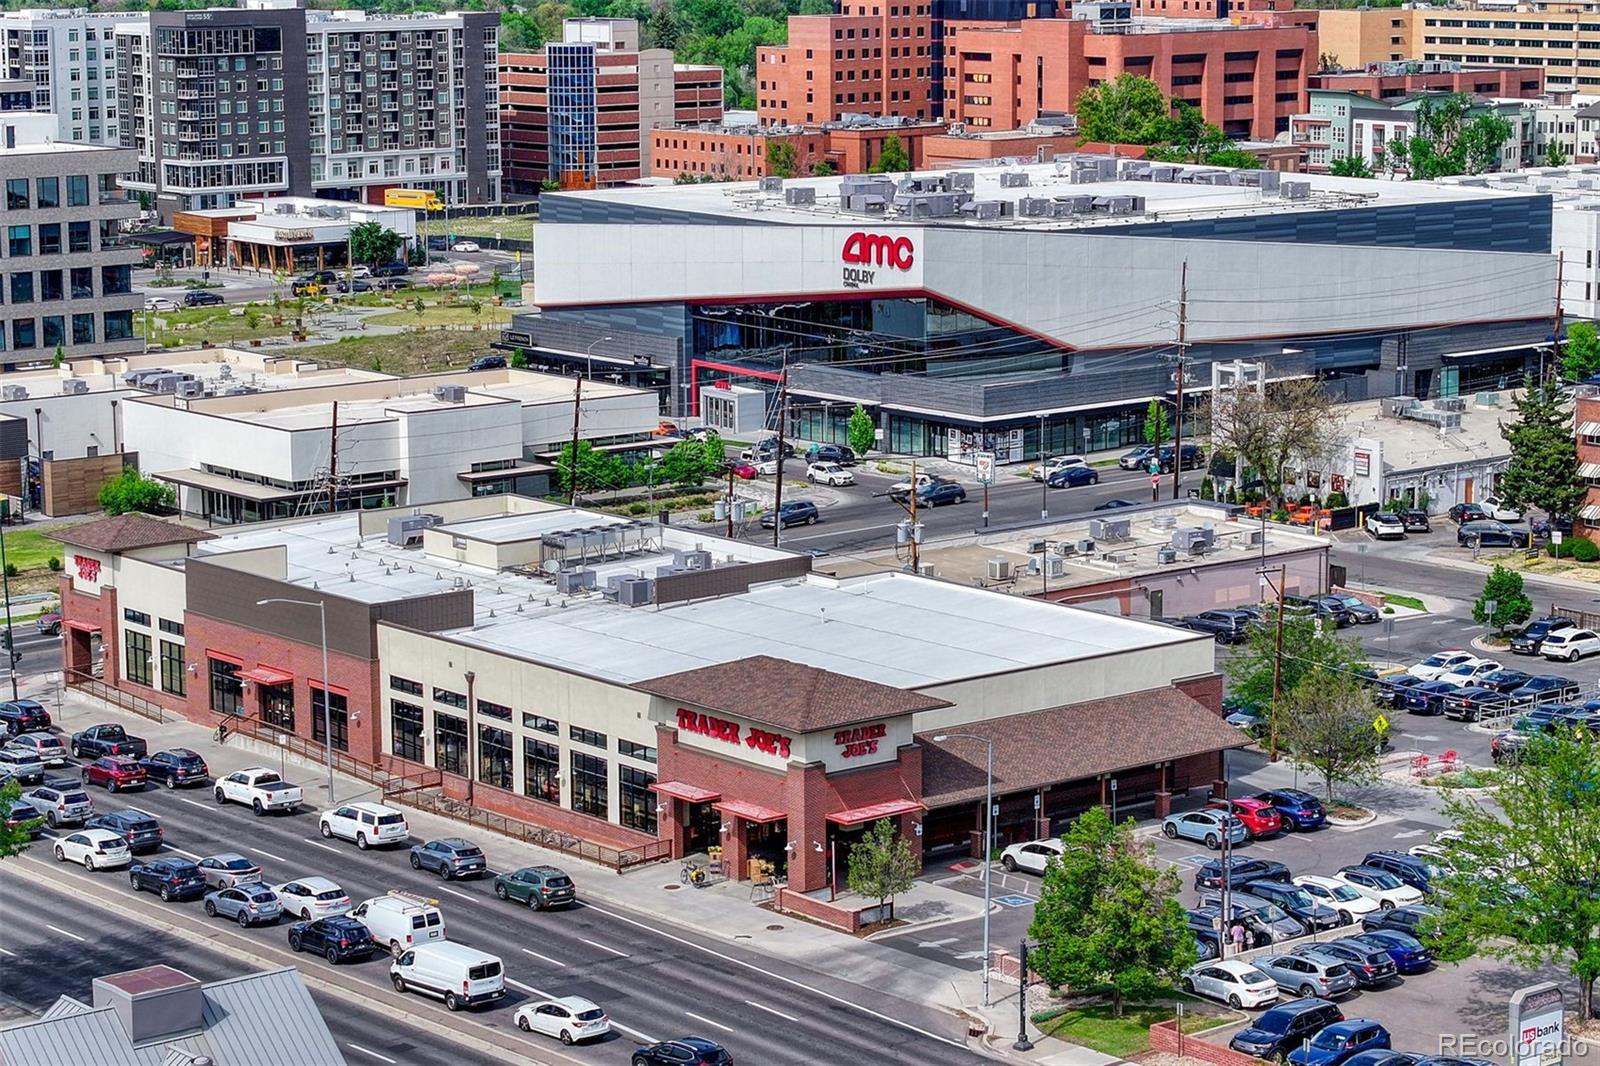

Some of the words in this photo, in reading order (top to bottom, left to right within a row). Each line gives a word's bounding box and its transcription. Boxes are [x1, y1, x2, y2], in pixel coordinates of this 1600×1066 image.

[843, 267, 875, 284] DOLBY
[676, 708, 741, 745] TRADER
[745, 727, 792, 758] JOE'S
[834, 723, 887, 745] TRADER
[841, 740, 879, 758] JOE'S
[1537, 1021, 1560, 1038] bank
